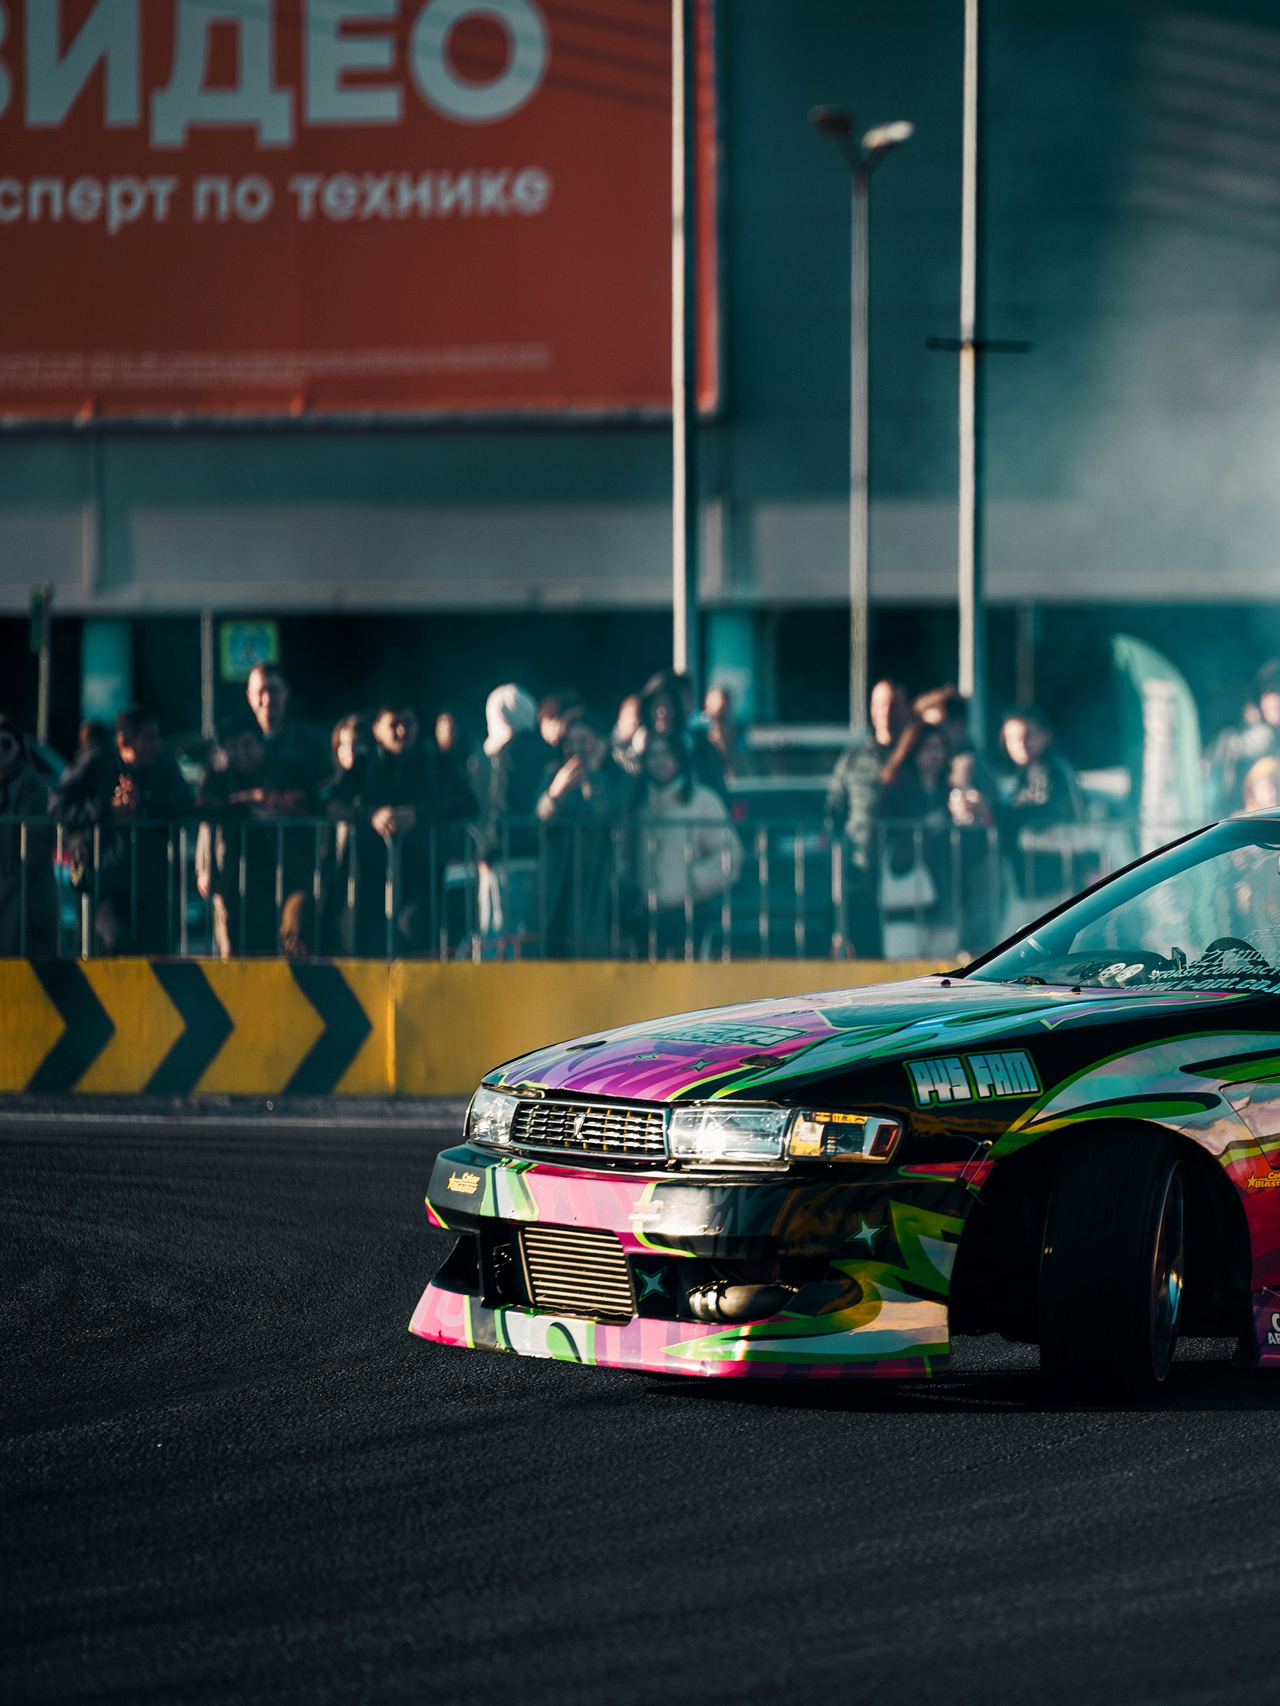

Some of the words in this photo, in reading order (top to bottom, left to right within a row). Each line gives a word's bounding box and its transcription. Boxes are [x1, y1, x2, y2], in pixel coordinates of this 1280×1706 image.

[0, 0, 550, 147] ИДЕО
[193, 175, 272, 222] по
[290, 166, 550, 222] технике
